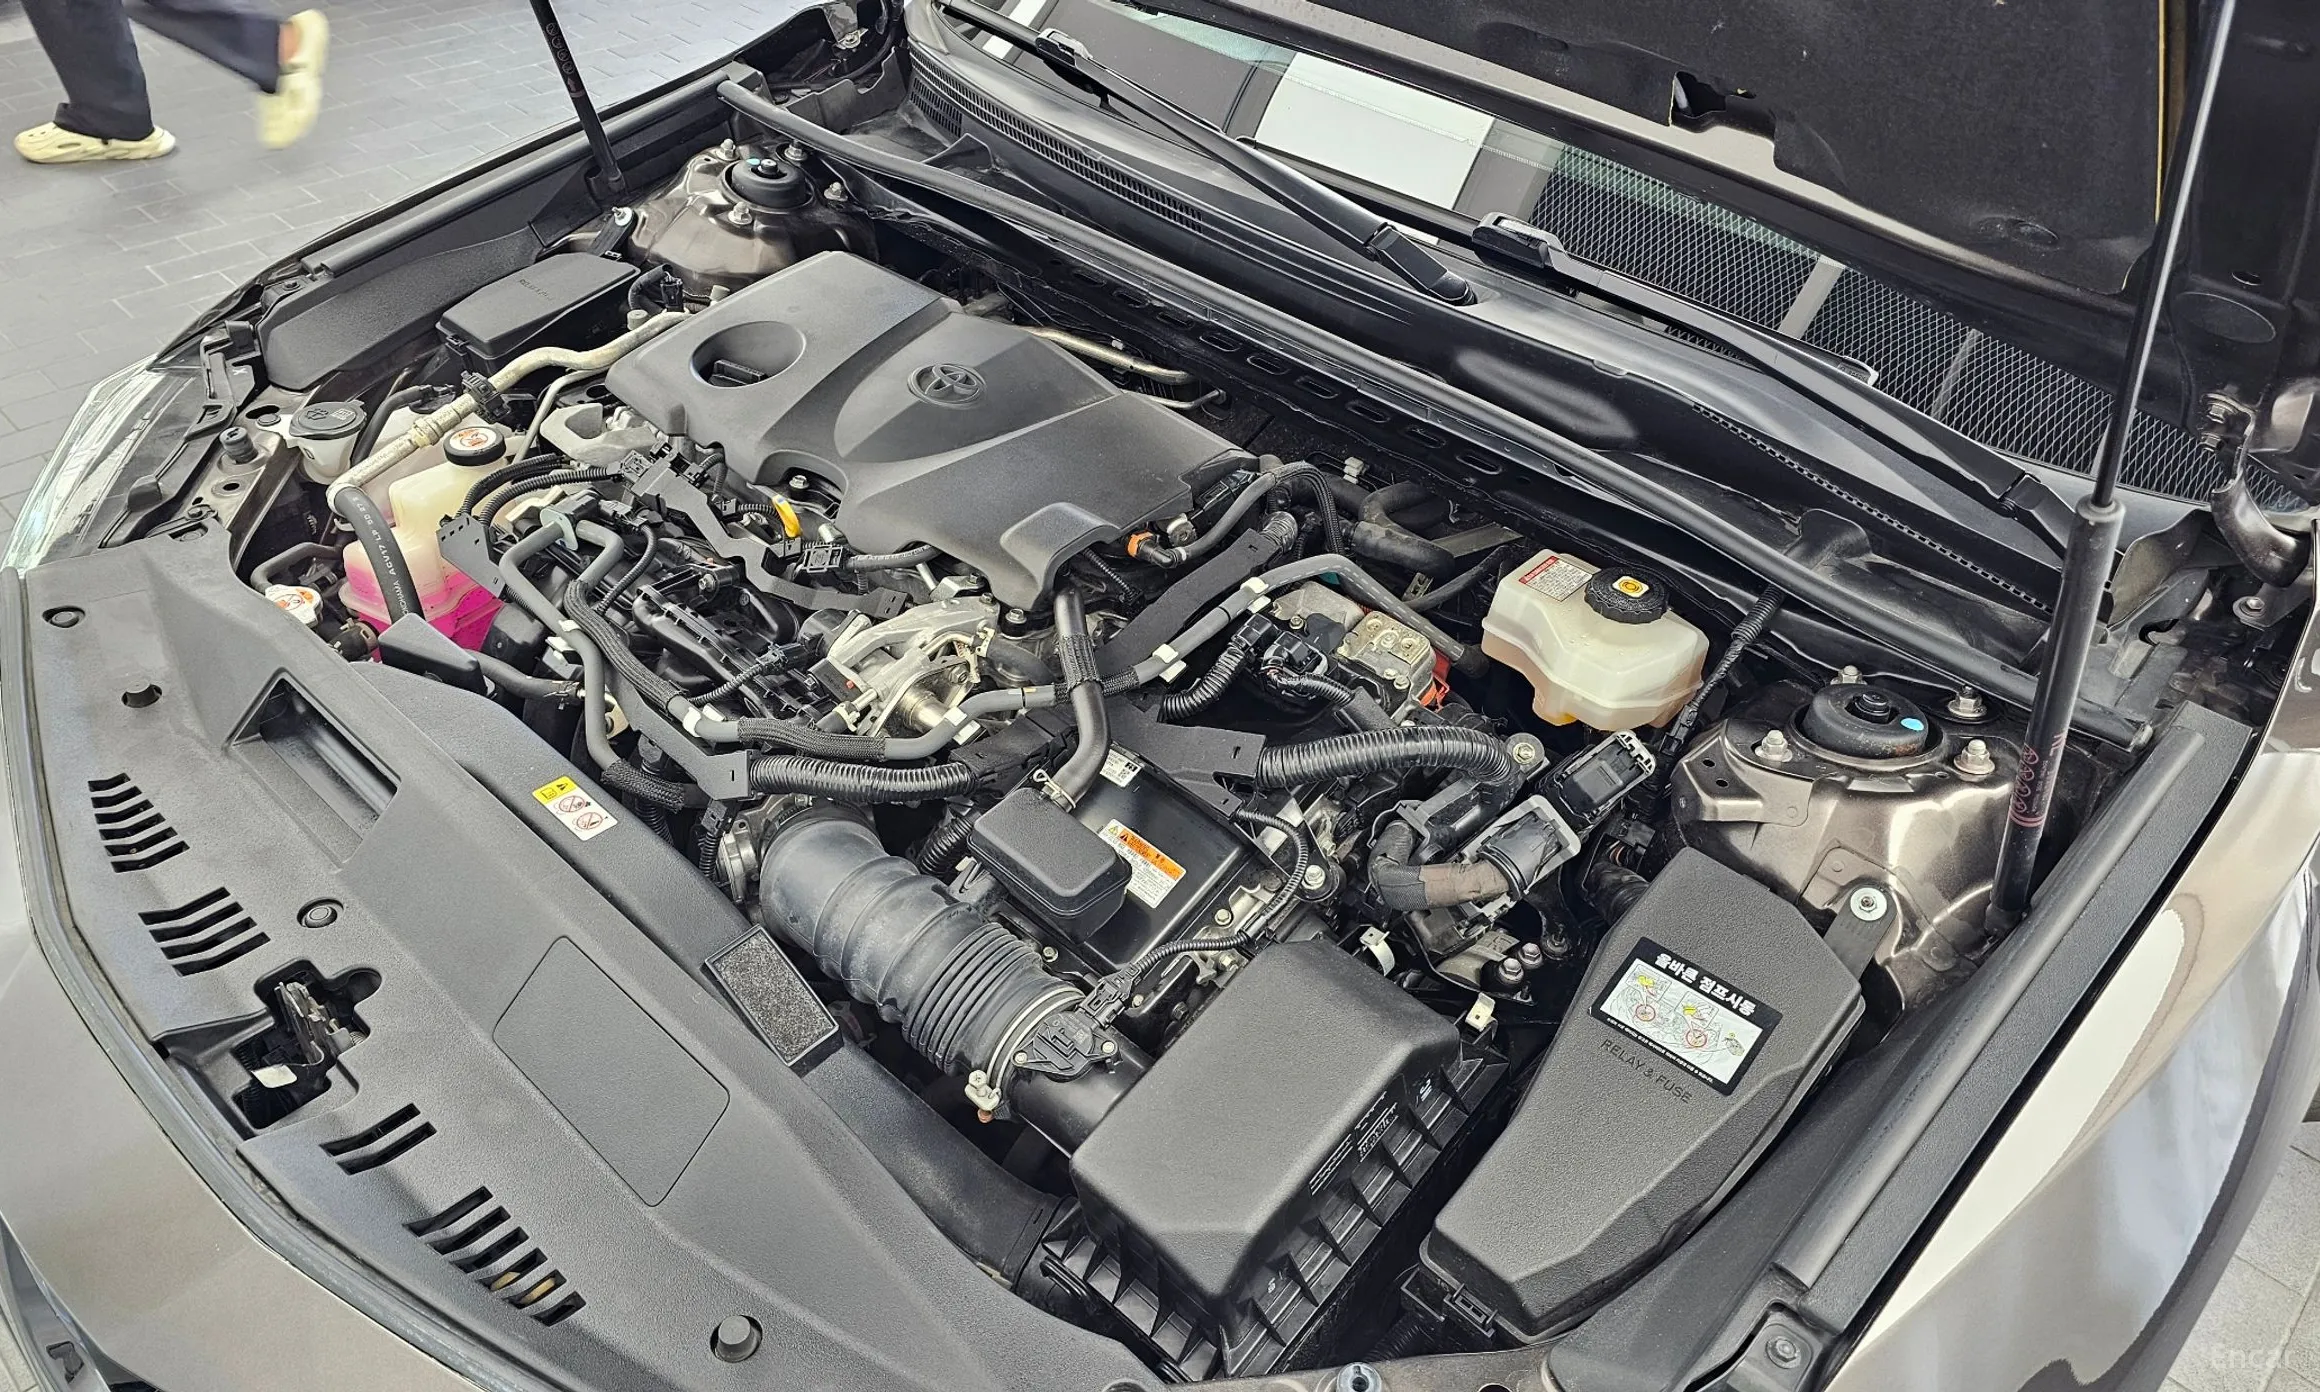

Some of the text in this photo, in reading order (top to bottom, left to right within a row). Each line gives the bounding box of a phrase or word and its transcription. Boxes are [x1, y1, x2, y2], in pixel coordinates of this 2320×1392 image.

[378, 544, 397, 575] ACV17
[1654, 953, 1757, 1017] 올바른 점프시동
[1600, 1038, 1647, 1070] RELAY
[1655, 1075, 1693, 1104] FUSE
